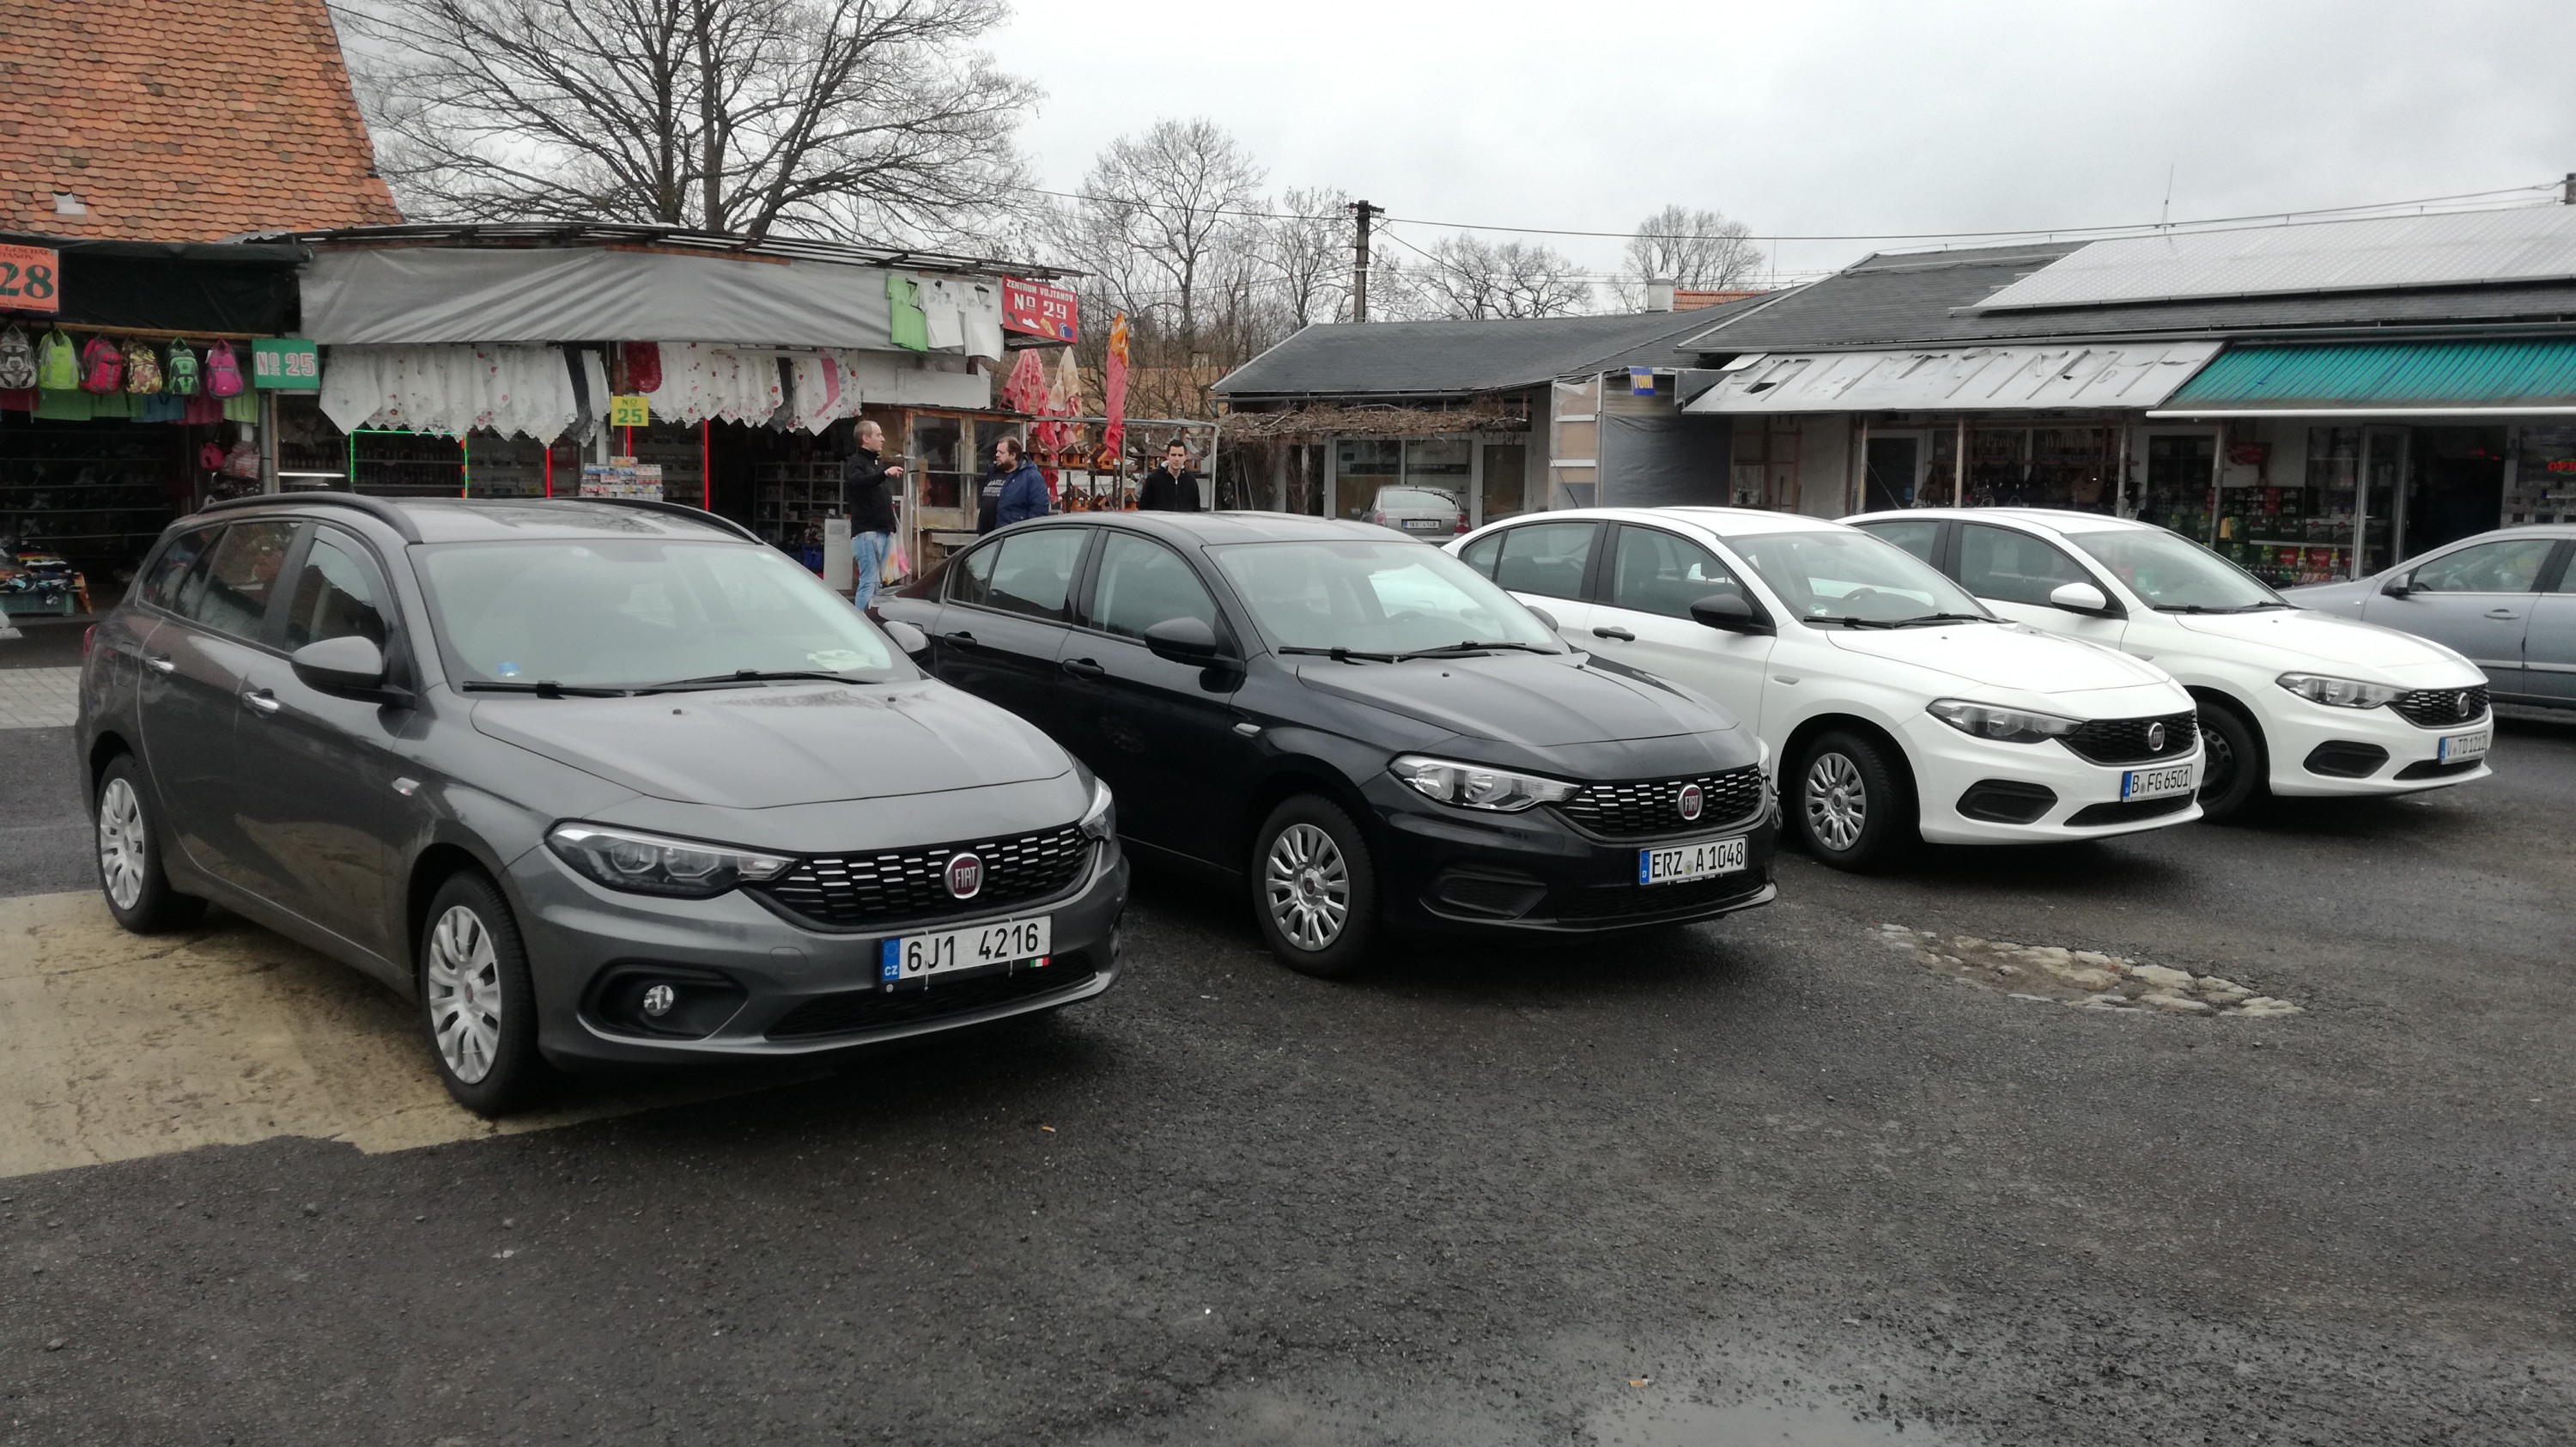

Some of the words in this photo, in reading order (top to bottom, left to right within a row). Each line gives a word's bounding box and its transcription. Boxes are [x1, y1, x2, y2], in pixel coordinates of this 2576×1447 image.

[0, 262, 54, 299] 28
[1005, 278, 1037, 295] ZENTRUM
[1043, 300, 1066, 319] 29
[285, 352, 315, 376] 25
[1632, 374, 1654, 389] TONI
[617, 408, 642, 423] 25
[2131, 775, 2140, 793] B
[2147, 772, 2162, 793] FG
[2164, 769, 2189, 789] 6501
[1685, 794, 1698, 812] FIAT
[1651, 850, 1683, 879] ERZ
[1696, 848, 1704, 872] A
[1708, 842, 1743, 871] 1048
[955, 866, 977, 889] FIAT
[908, 935, 955, 972] 6J1
[978, 923, 1039, 960] 4216
[884, 964, 898, 976] CZ
